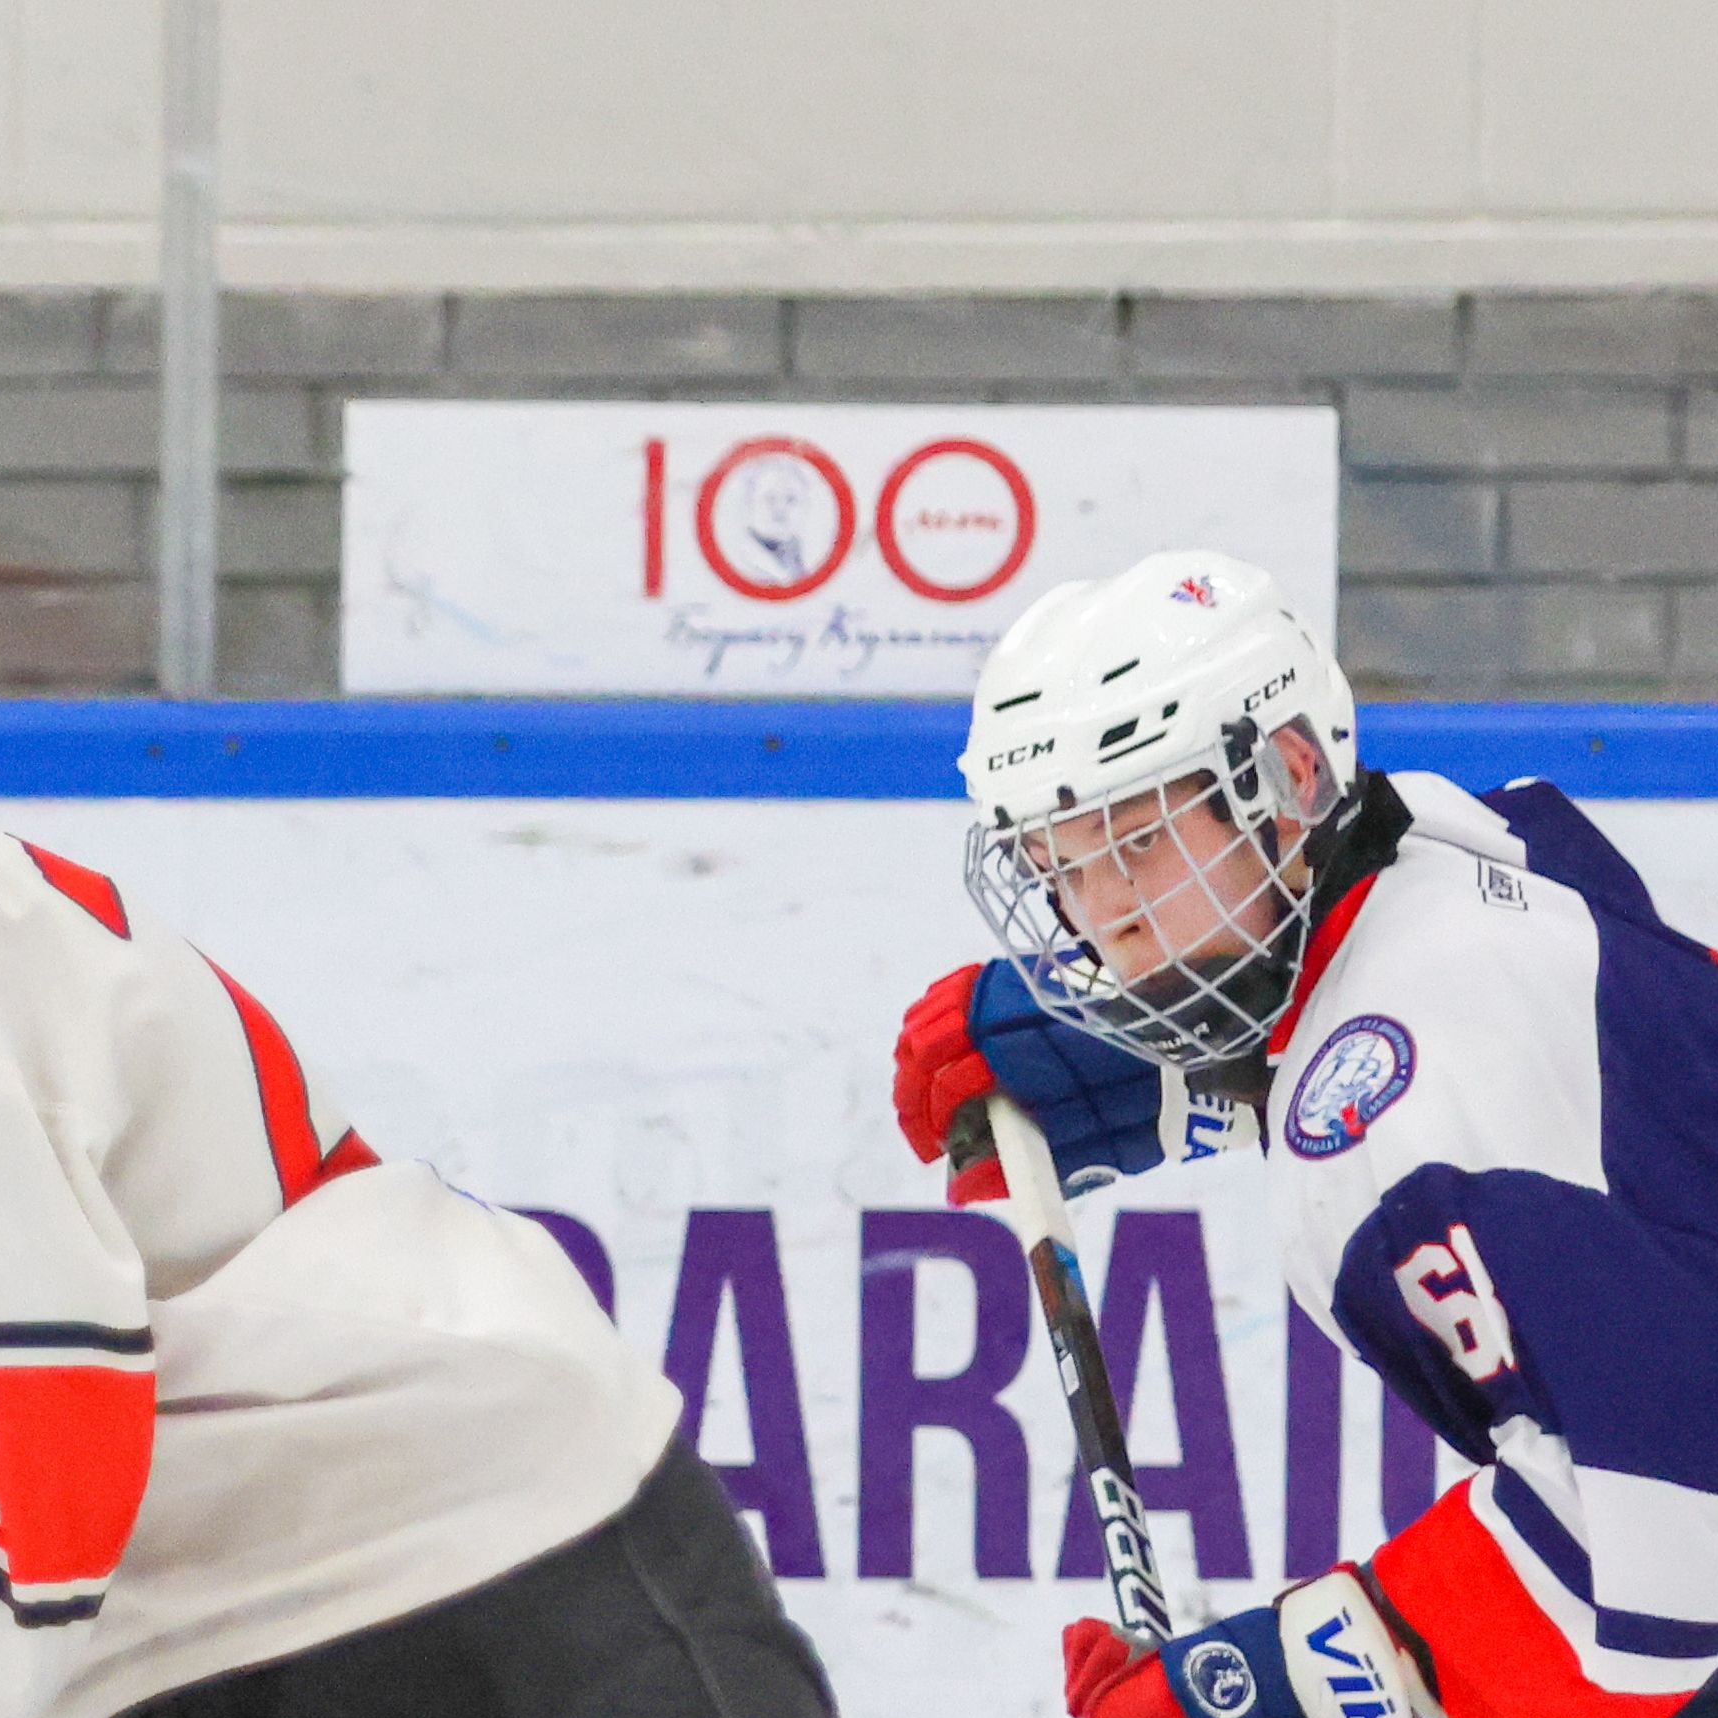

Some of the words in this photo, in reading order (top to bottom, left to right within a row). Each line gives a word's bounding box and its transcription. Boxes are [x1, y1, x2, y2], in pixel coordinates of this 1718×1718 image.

[645, 434, 1035, 604] 100
[1243, 667, 1297, 713] CCM
[987, 737, 1056, 772] CCM
